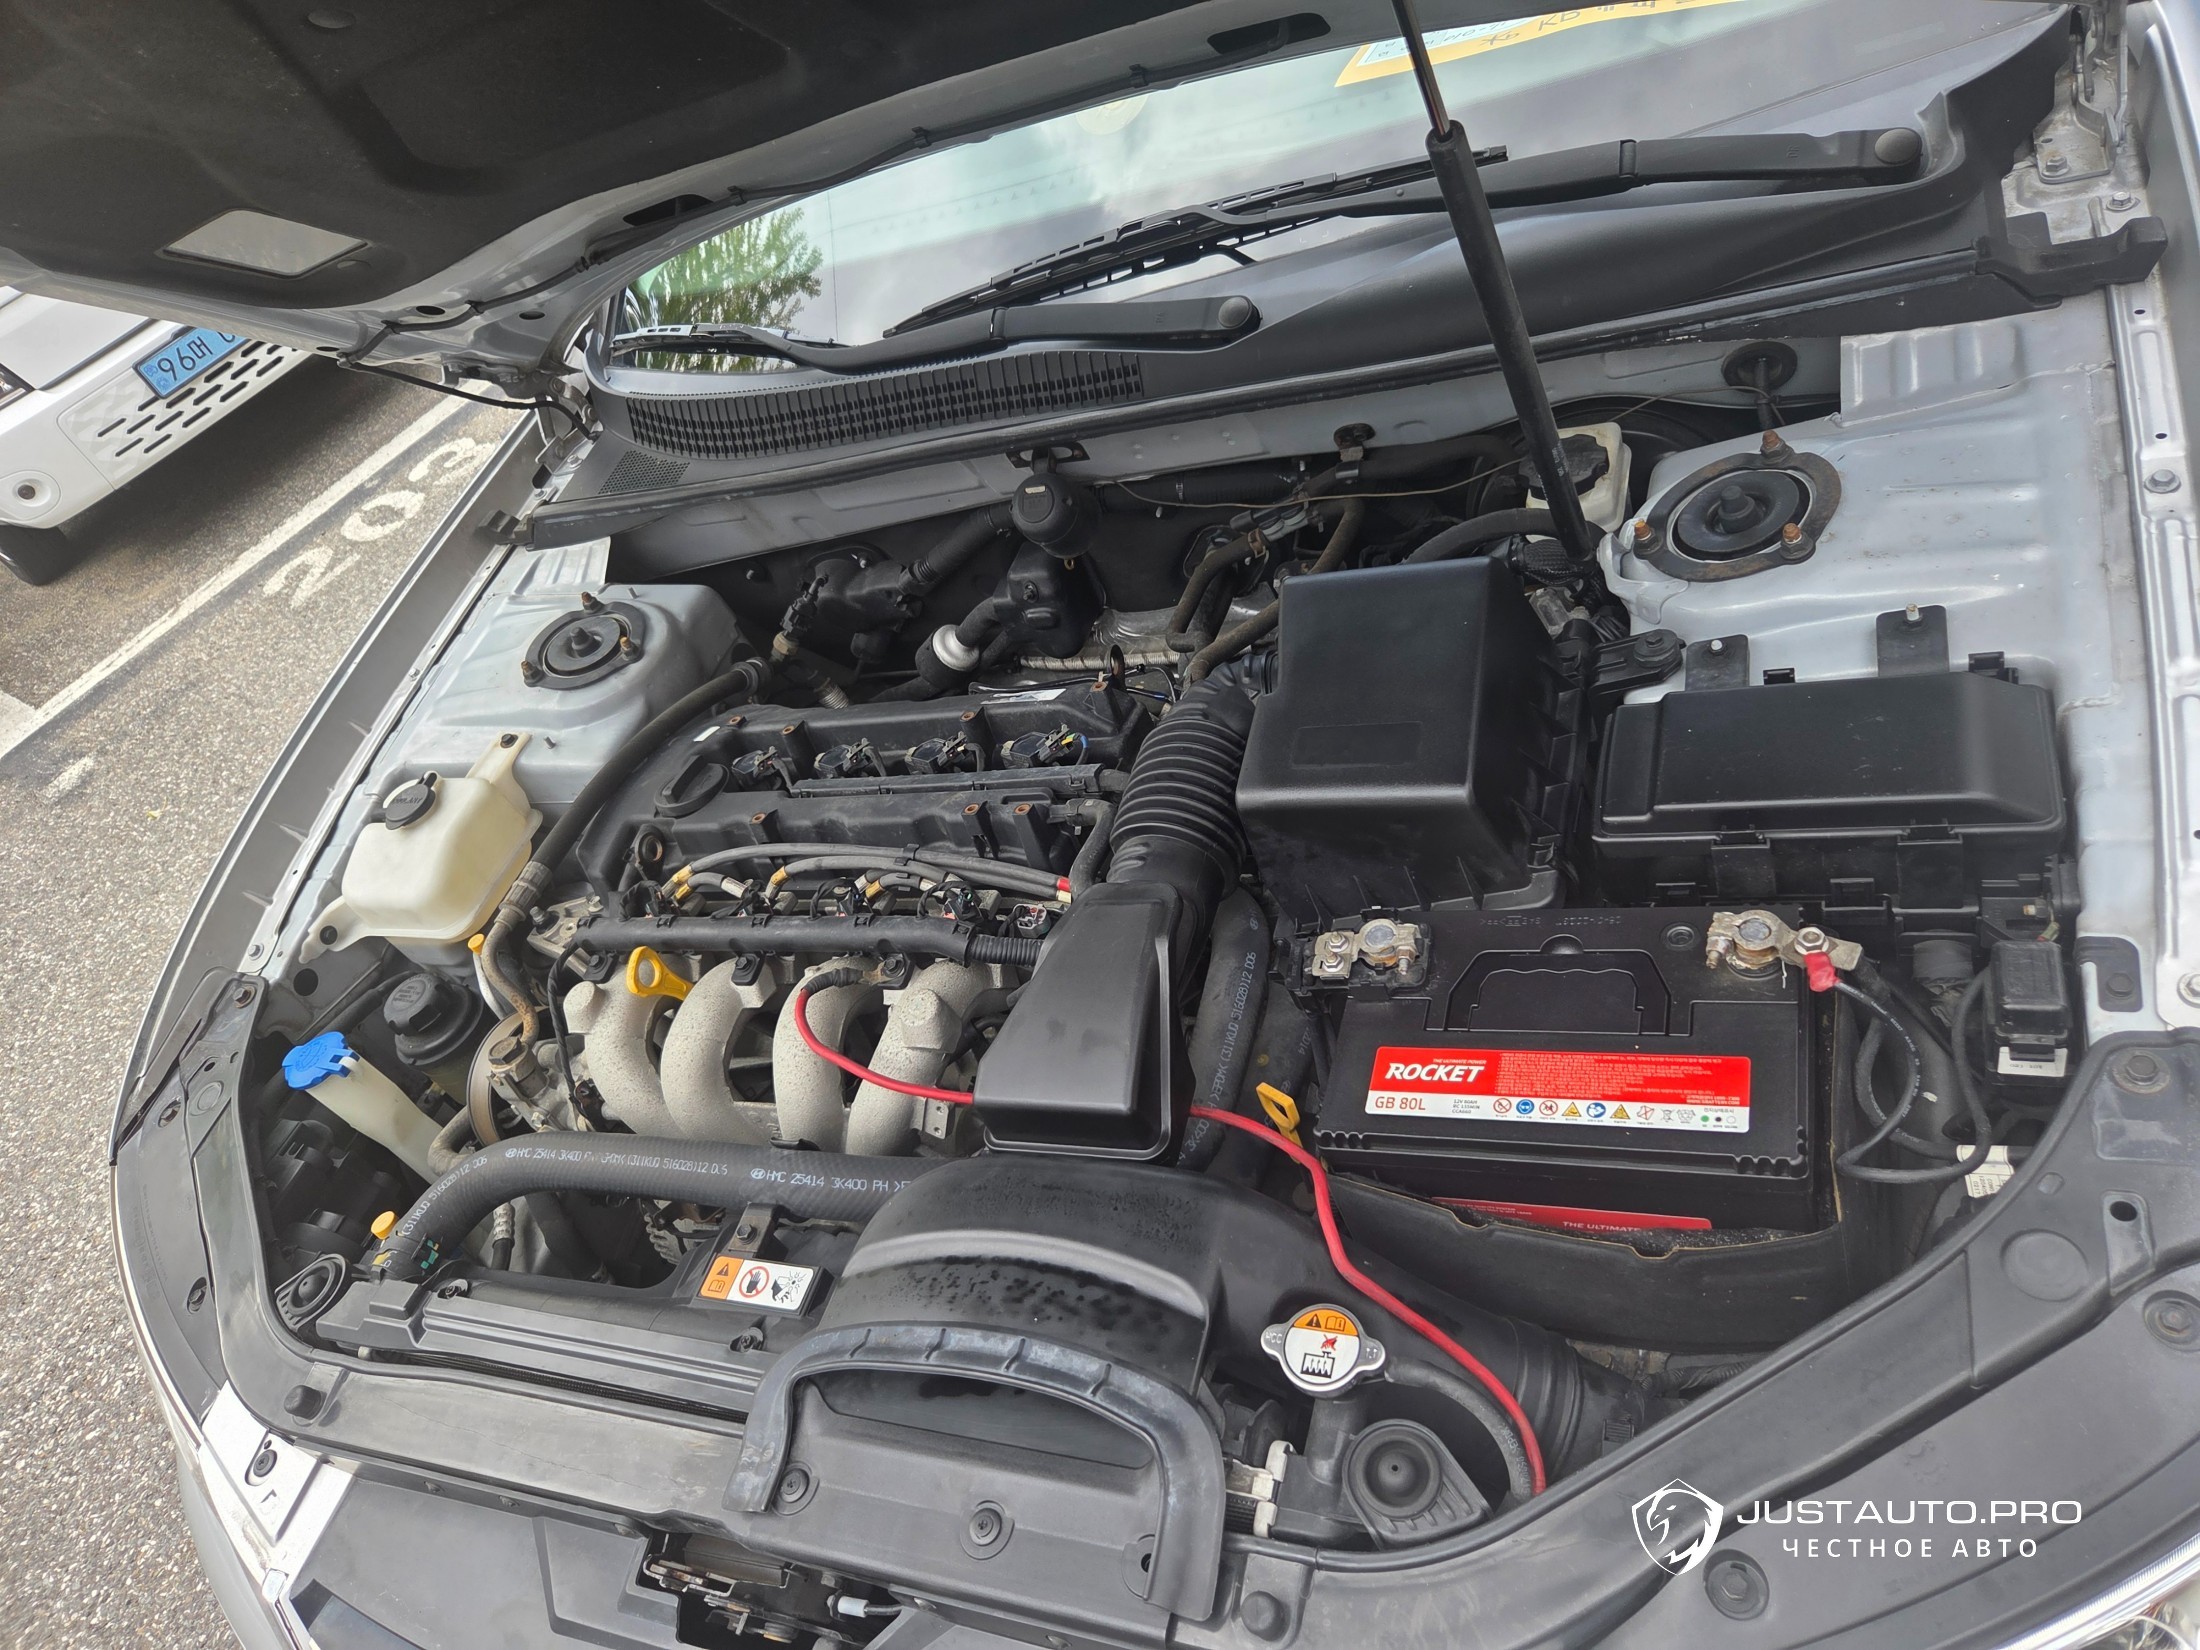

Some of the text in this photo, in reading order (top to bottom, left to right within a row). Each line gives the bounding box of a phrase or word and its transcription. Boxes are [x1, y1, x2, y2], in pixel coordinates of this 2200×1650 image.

[264, 437, 492, 608] 203
[1385, 1063, 1485, 1083] ROCKET
[1375, 1096, 1426, 1111] GB 80L
[790, 1173, 825, 1187] 25414
[831, 1177, 867, 1191] 3K400
[873, 1180, 889, 1192] PH
[1562, 1221, 1584, 1229] THE
